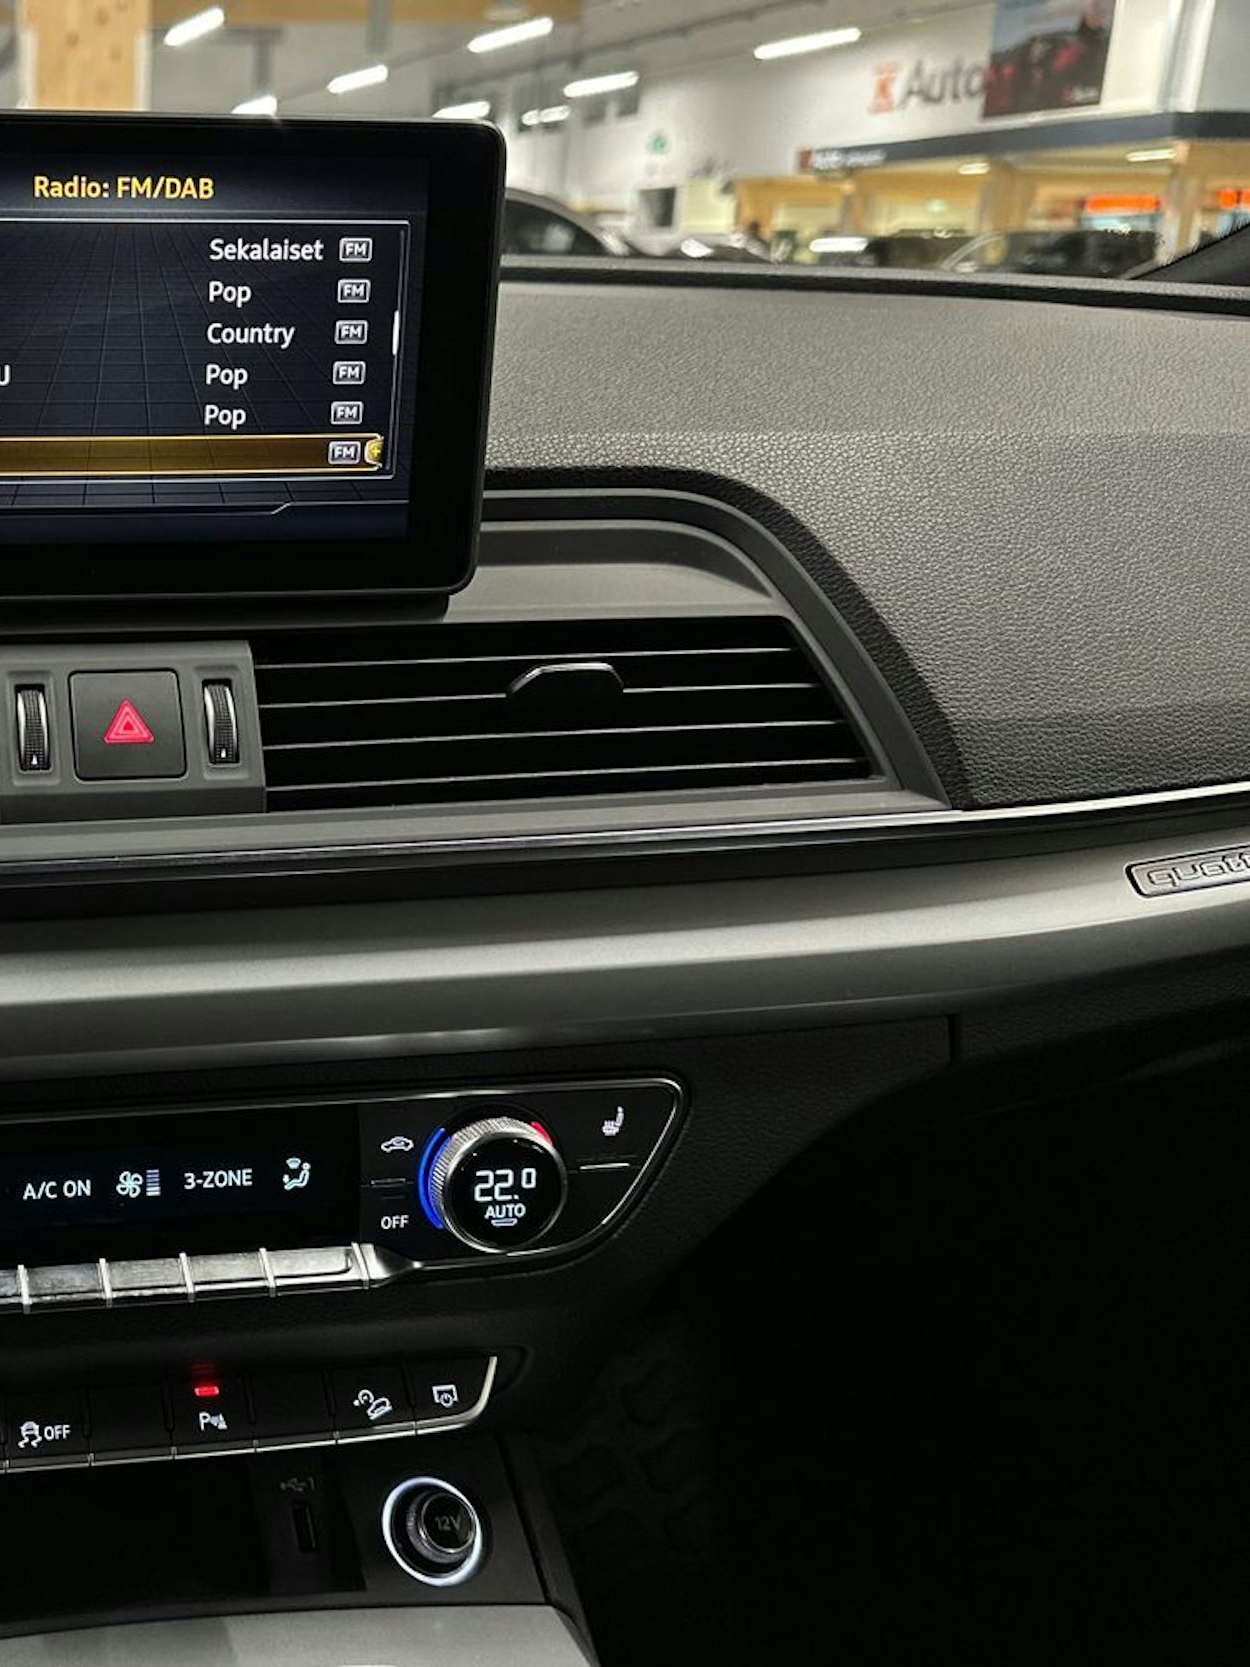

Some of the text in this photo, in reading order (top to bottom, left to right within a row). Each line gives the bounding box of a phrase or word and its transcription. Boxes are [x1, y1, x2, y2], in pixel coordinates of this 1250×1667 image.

[34, 175, 215, 200] Radio: FM/DAB
[209, 237, 325, 261] Sekalaiset
[345, 243, 367, 257] FM
[208, 281, 252, 308] Pop
[343, 285, 365, 298] FM
[207, 322, 296, 349] Country
[340, 326, 363, 340] FM
[205, 363, 249, 390] Pop
[338, 366, 360, 380] FM
[204, 404, 247, 430] Pop
[336, 407, 358, 420] FM
[334, 446, 356, 459] FM
[22, 1179, 92, 1200] A/C ON
[184, 1168, 253, 1190] 3-ZONE
[380, 1214, 410, 1230] OFF
[484, 1203, 527, 1220] AUTO
[43, 1424, 71, 1441] OFF
[434, 1514, 462, 1532] 12V
